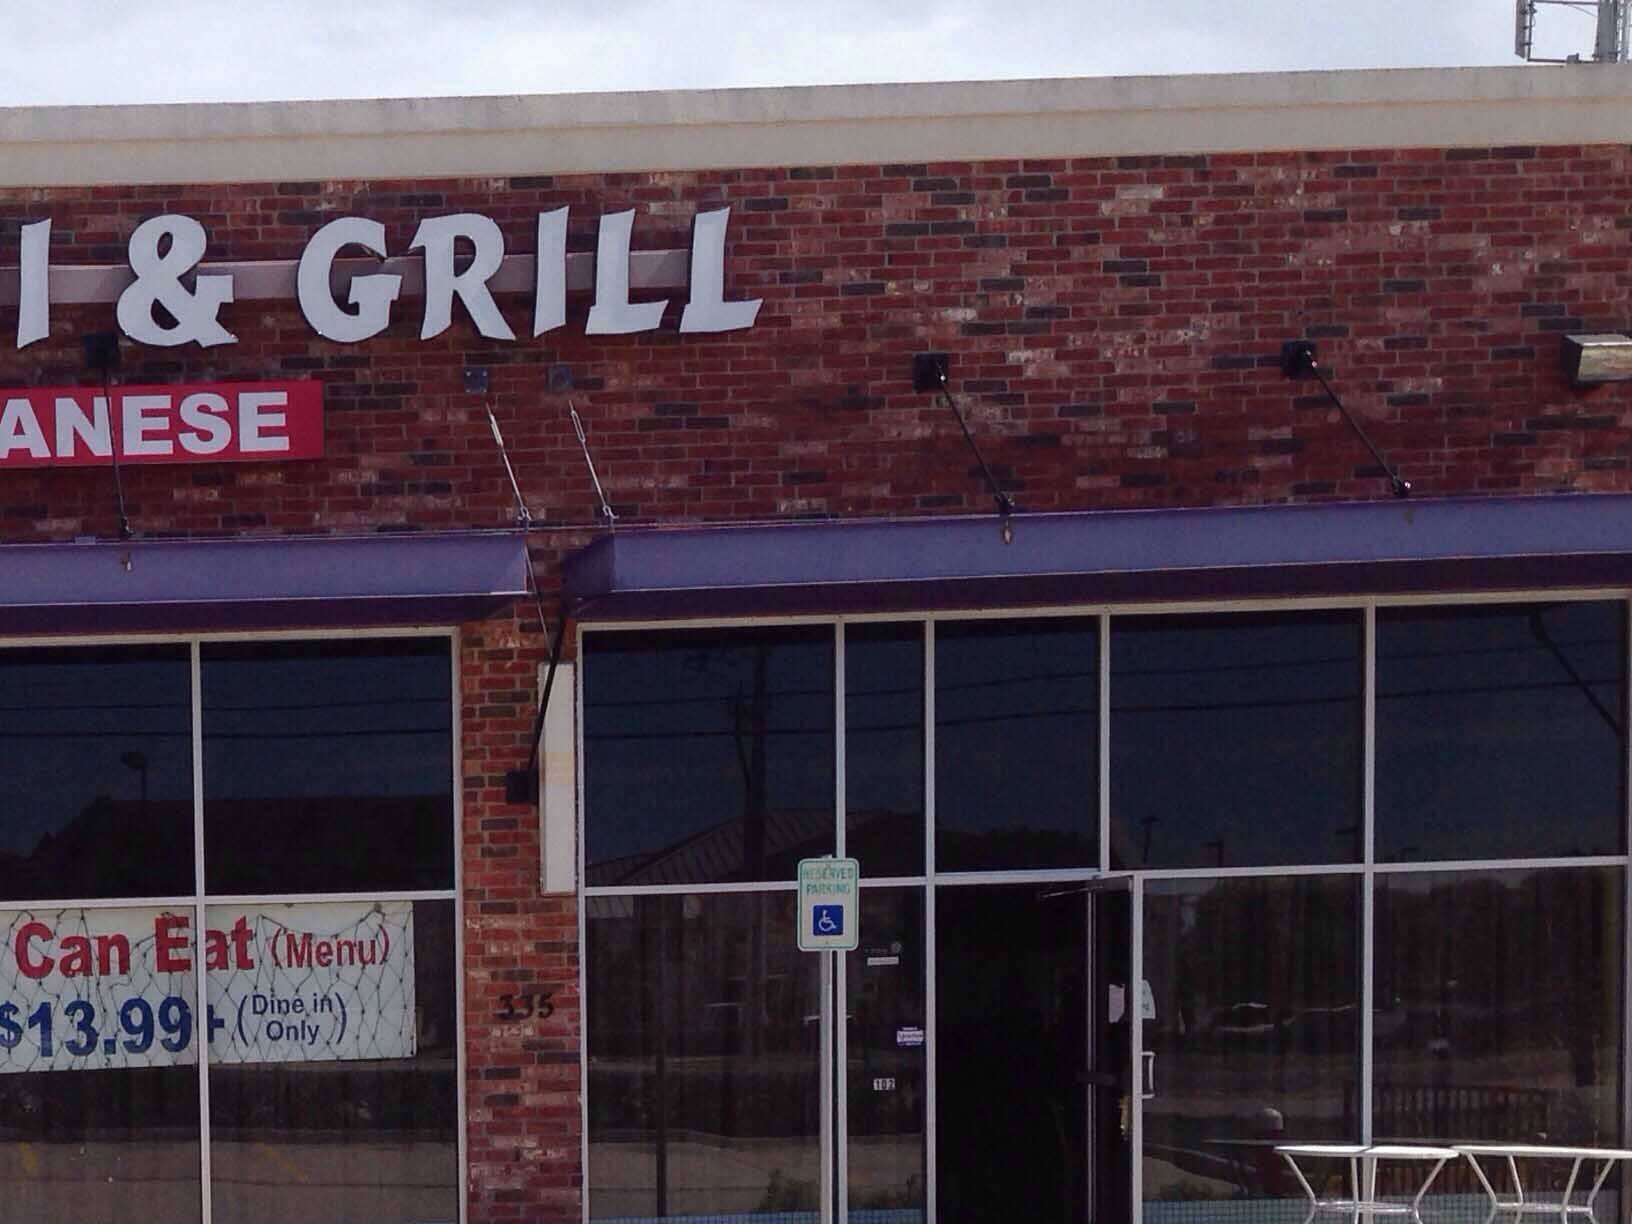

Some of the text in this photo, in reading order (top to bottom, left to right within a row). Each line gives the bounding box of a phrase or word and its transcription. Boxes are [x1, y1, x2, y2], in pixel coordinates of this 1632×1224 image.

[114, 213, 239, 348] &
[296, 205, 765, 344] GRILL
[806, 883, 850, 895] PARKING
[15, 920, 131, 979] Can
[154, 915, 255, 974] Eat
[272, 923, 390, 971] (Menu)
